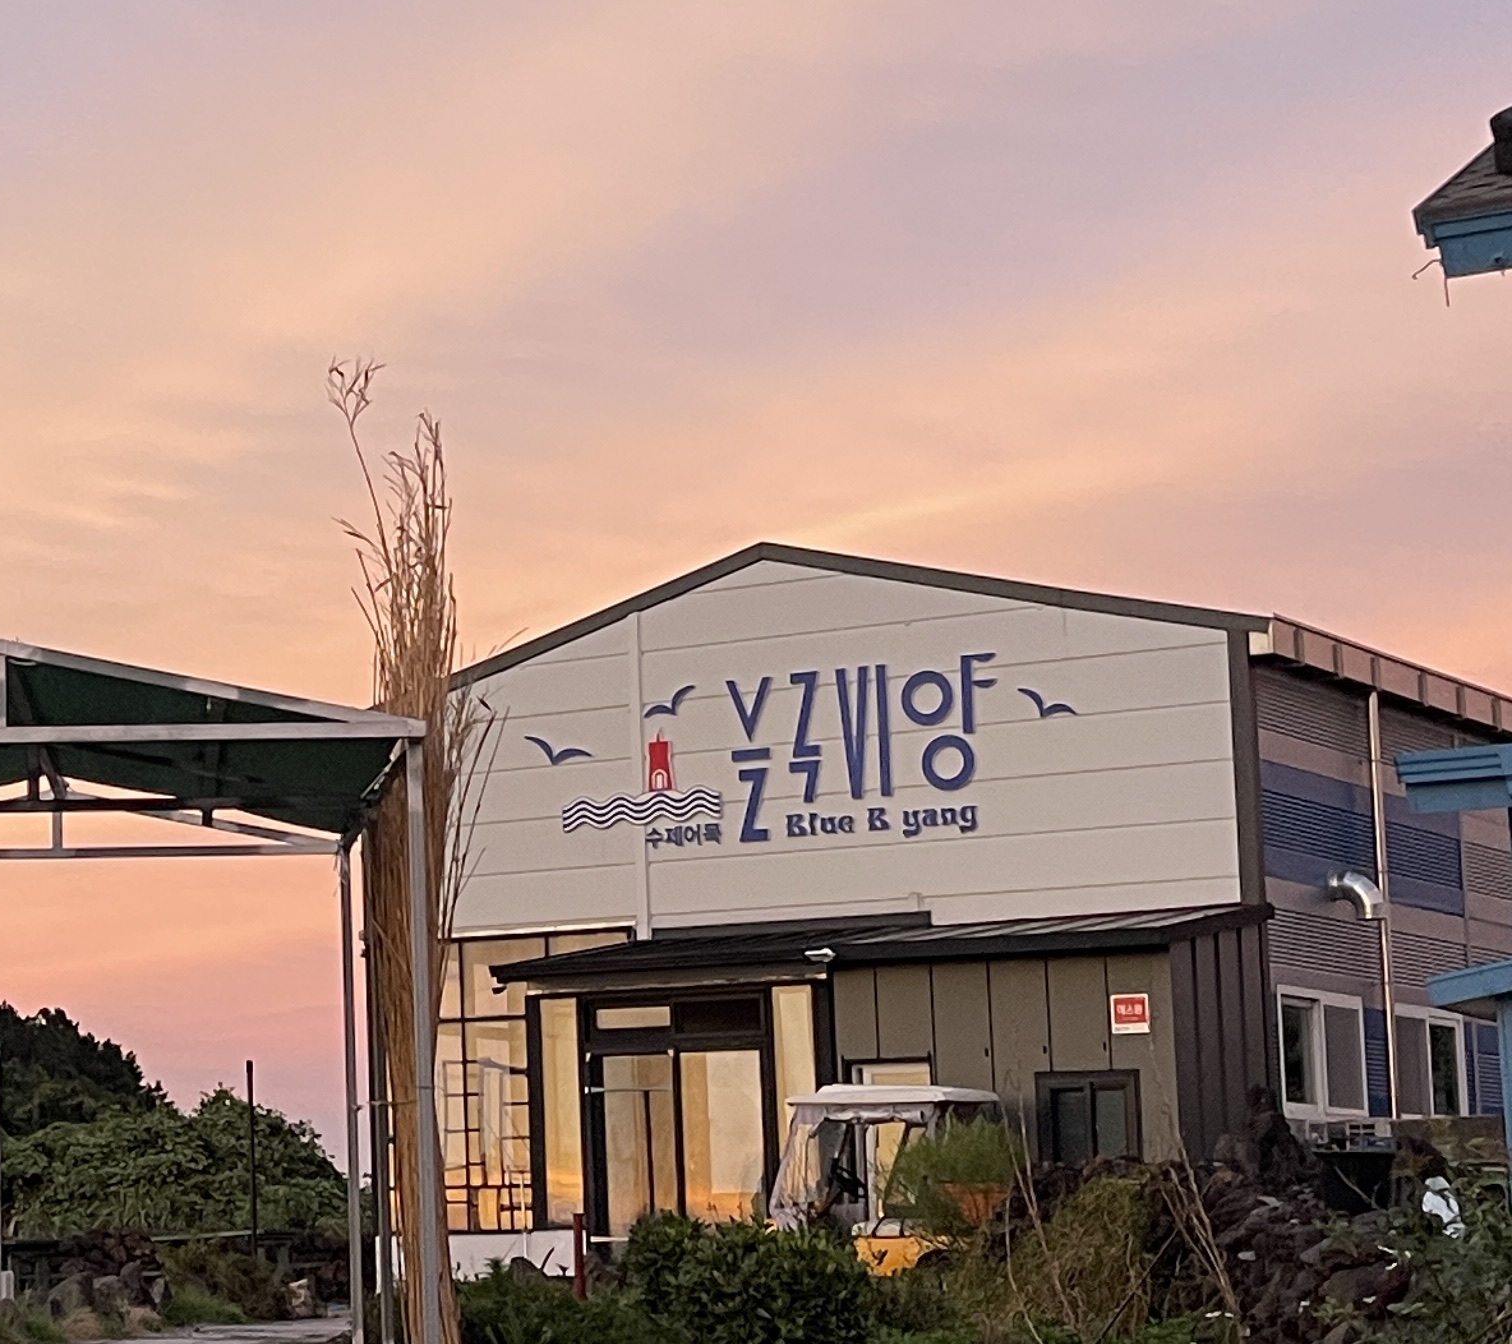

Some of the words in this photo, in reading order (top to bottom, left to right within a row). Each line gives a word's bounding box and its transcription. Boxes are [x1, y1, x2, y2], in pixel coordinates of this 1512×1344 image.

[786, 812, 855, 838] Blue
[868, 808, 891, 832] B
[903, 806, 979, 839] yang
